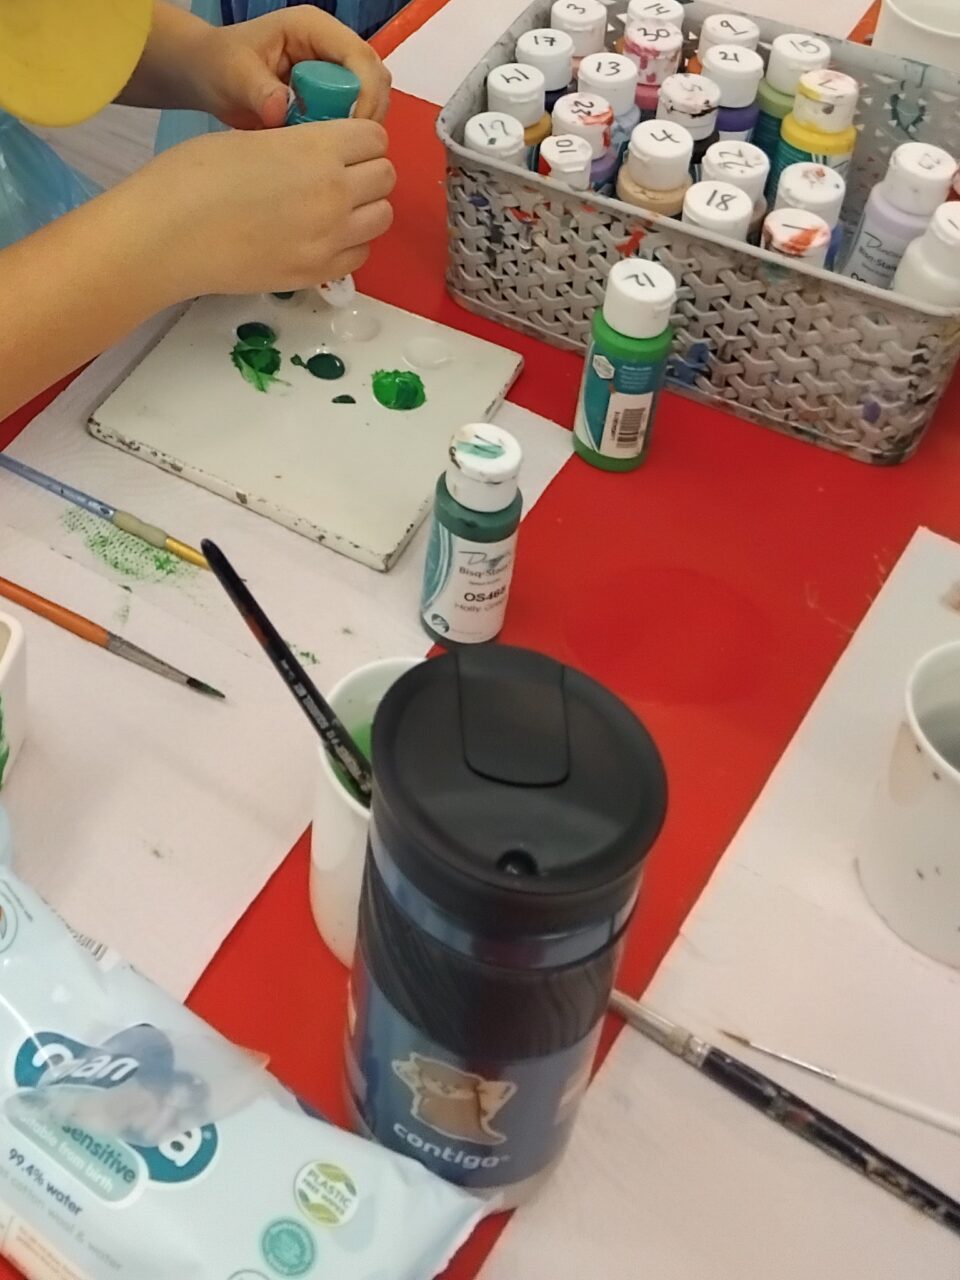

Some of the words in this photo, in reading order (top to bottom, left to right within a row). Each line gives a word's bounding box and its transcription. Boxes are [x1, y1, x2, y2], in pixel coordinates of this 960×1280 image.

[640, 27, 670, 42] 30
[719, 50, 740, 63] 21
[595, 60, 621, 77] 13
[649, 128, 681, 144] 4
[705, 189, 737, 211] 18
[392, 1122, 501, 1170] contigo
[8, 1147, 45, 1186] 99.4%
[45, 1181, 83, 1216] water
